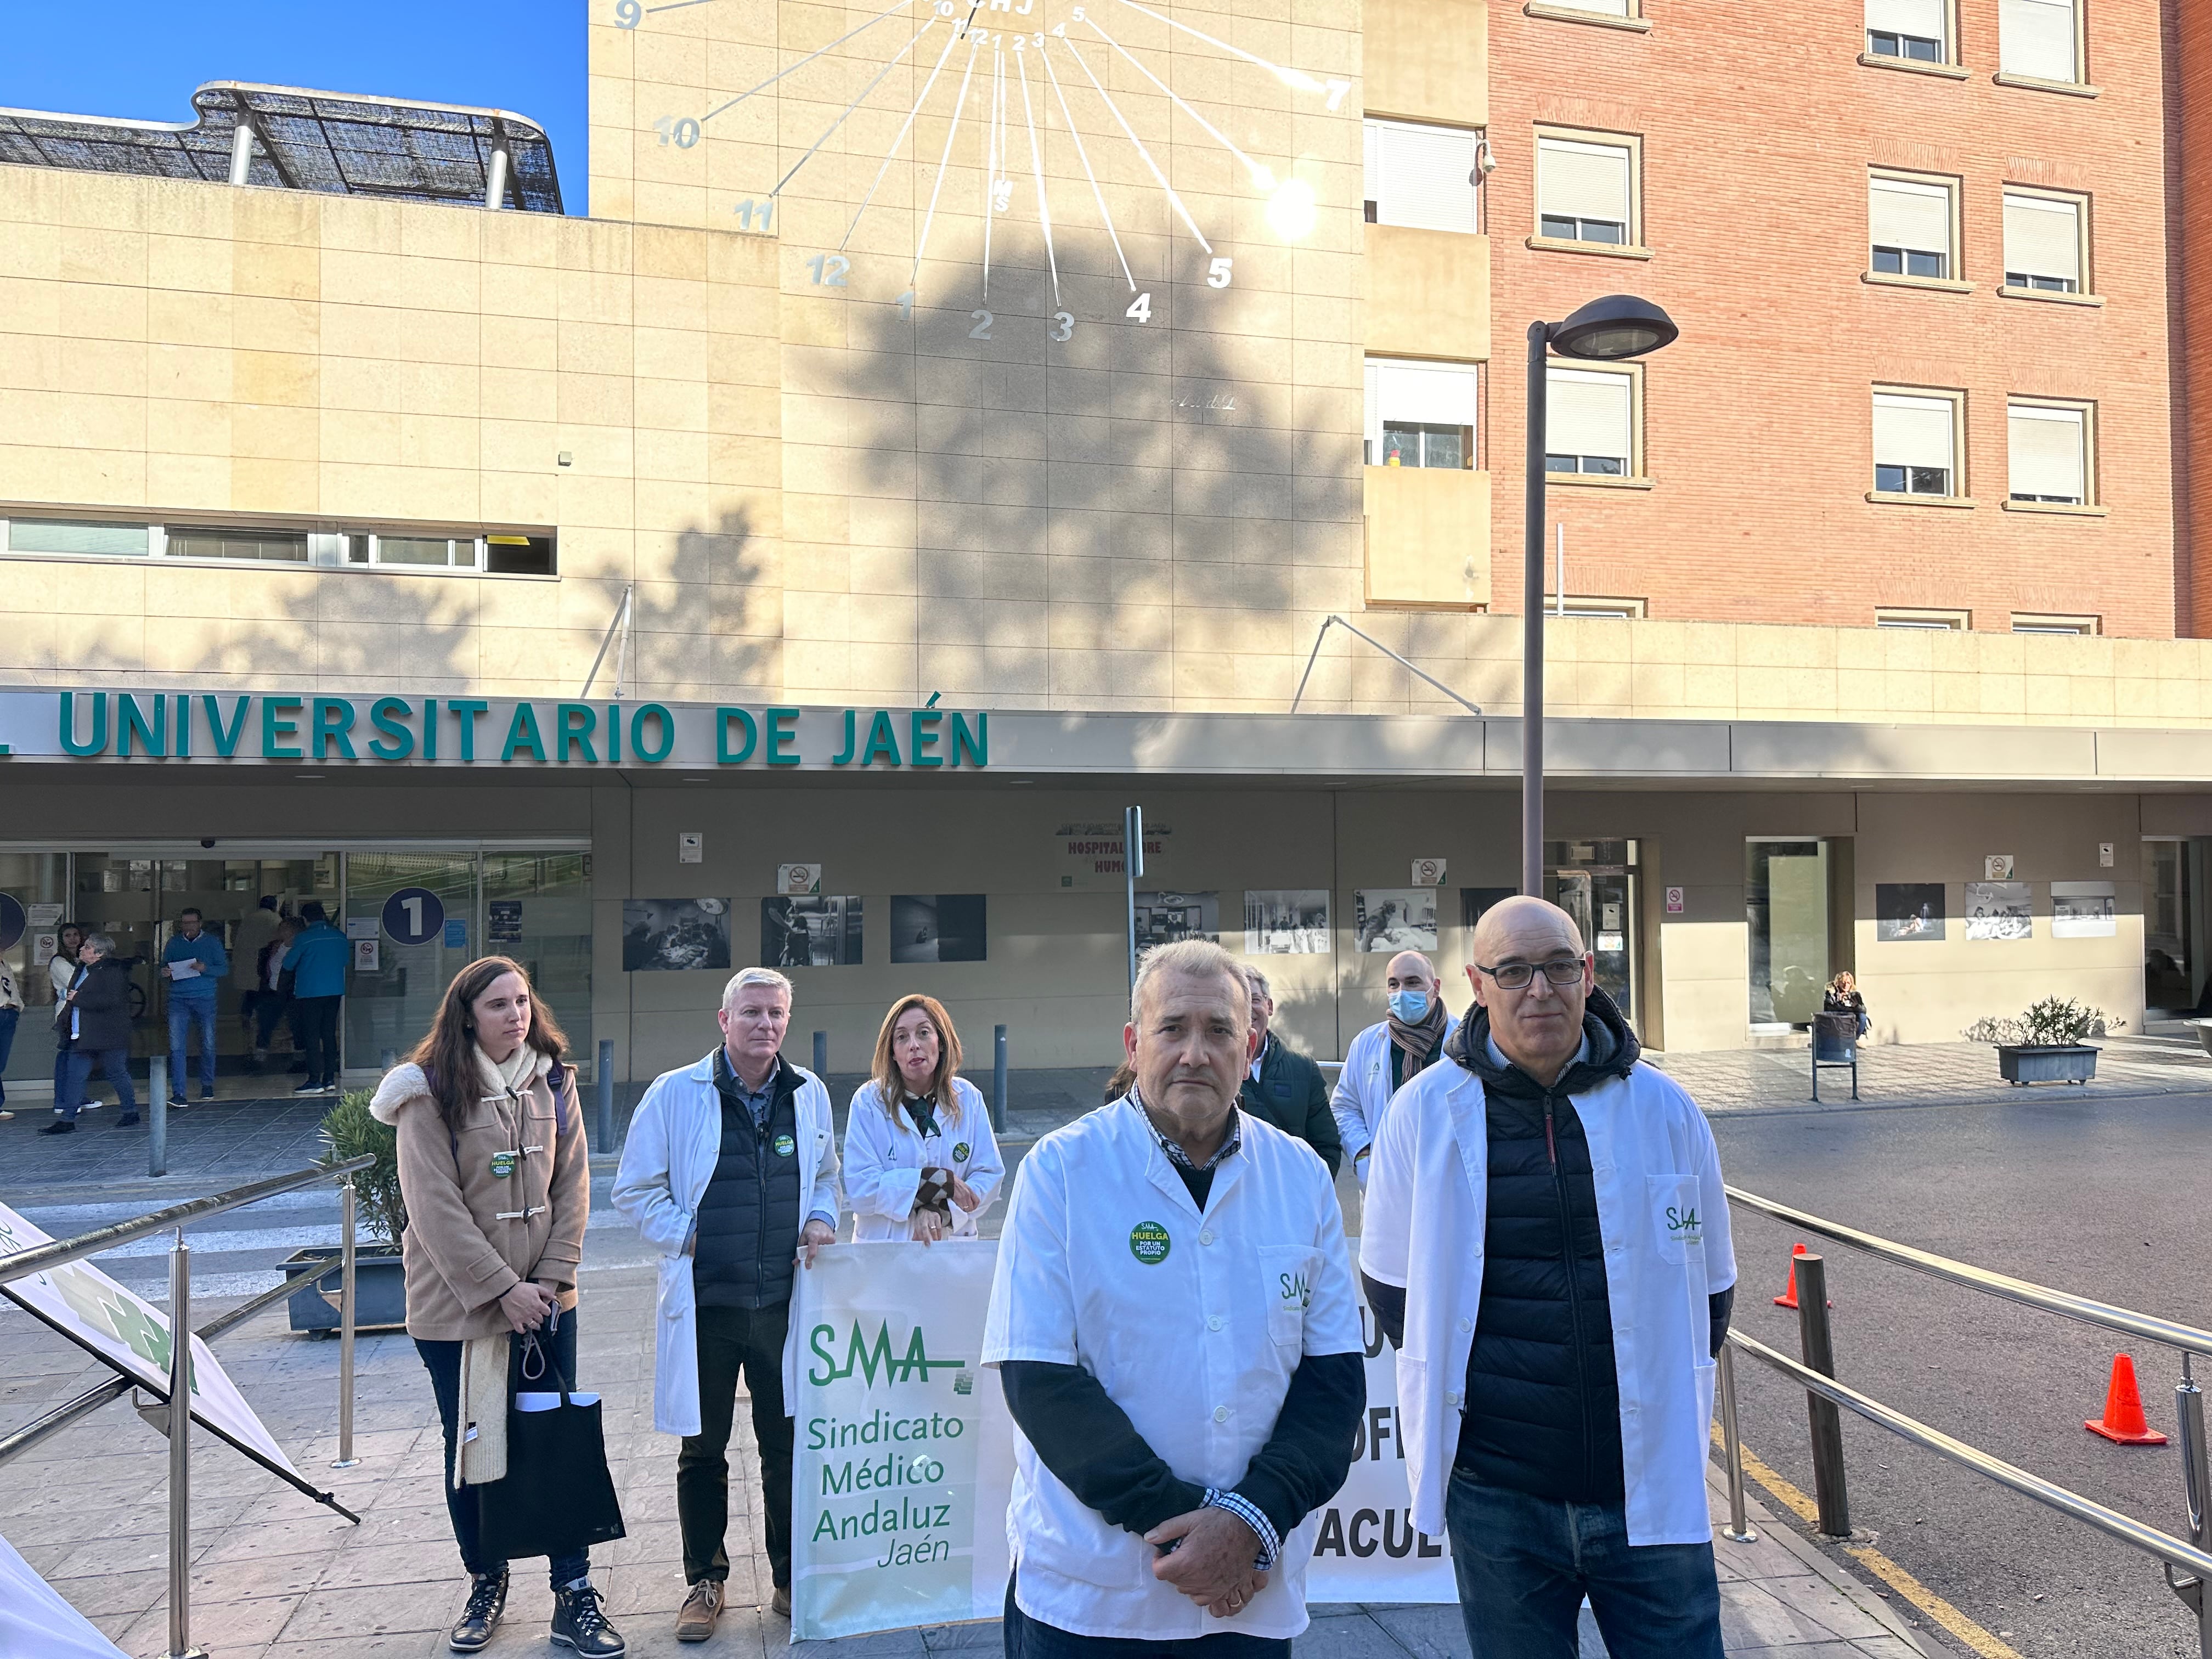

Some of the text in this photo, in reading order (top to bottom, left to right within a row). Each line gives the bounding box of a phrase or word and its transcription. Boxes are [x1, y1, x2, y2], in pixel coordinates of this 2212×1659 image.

[614, 0, 642, 30] 9
[934, 2, 954, 16] 10
[1072, 6, 1086, 22] 5
[968, 28, 989, 44] 12
[992, 34, 1002, 49] 1
[1012, 36, 1026, 51] 2
[1032, 32, 1045, 48] 3
[1052, 22, 1066, 37] 4
[1324, 80, 1350, 110] 7
[652, 115, 700, 149] 10
[733, 199, 774, 232] 11
[806, 253, 850, 286] 12
[1207, 258, 1233, 288] 5
[895, 291, 914, 321] 1
[1126, 293, 1151, 323] 4
[969, 311, 994, 340] 2
[1050, 313, 1074, 342] 3
[59, 690, 988, 767] UNIVERSITARIO DE JAÉN
[401, 897, 422, 936] 1
[1132, 1232, 1169, 1240] HUELGA
[809, 1317, 964, 1390] SMA
[808, 1409, 964, 1451] Sindicato
[822, 1453, 944, 1496] Médico
[812, 1496, 951, 1542] Andaluz
[877, 1534, 950, 1569] Jaén
